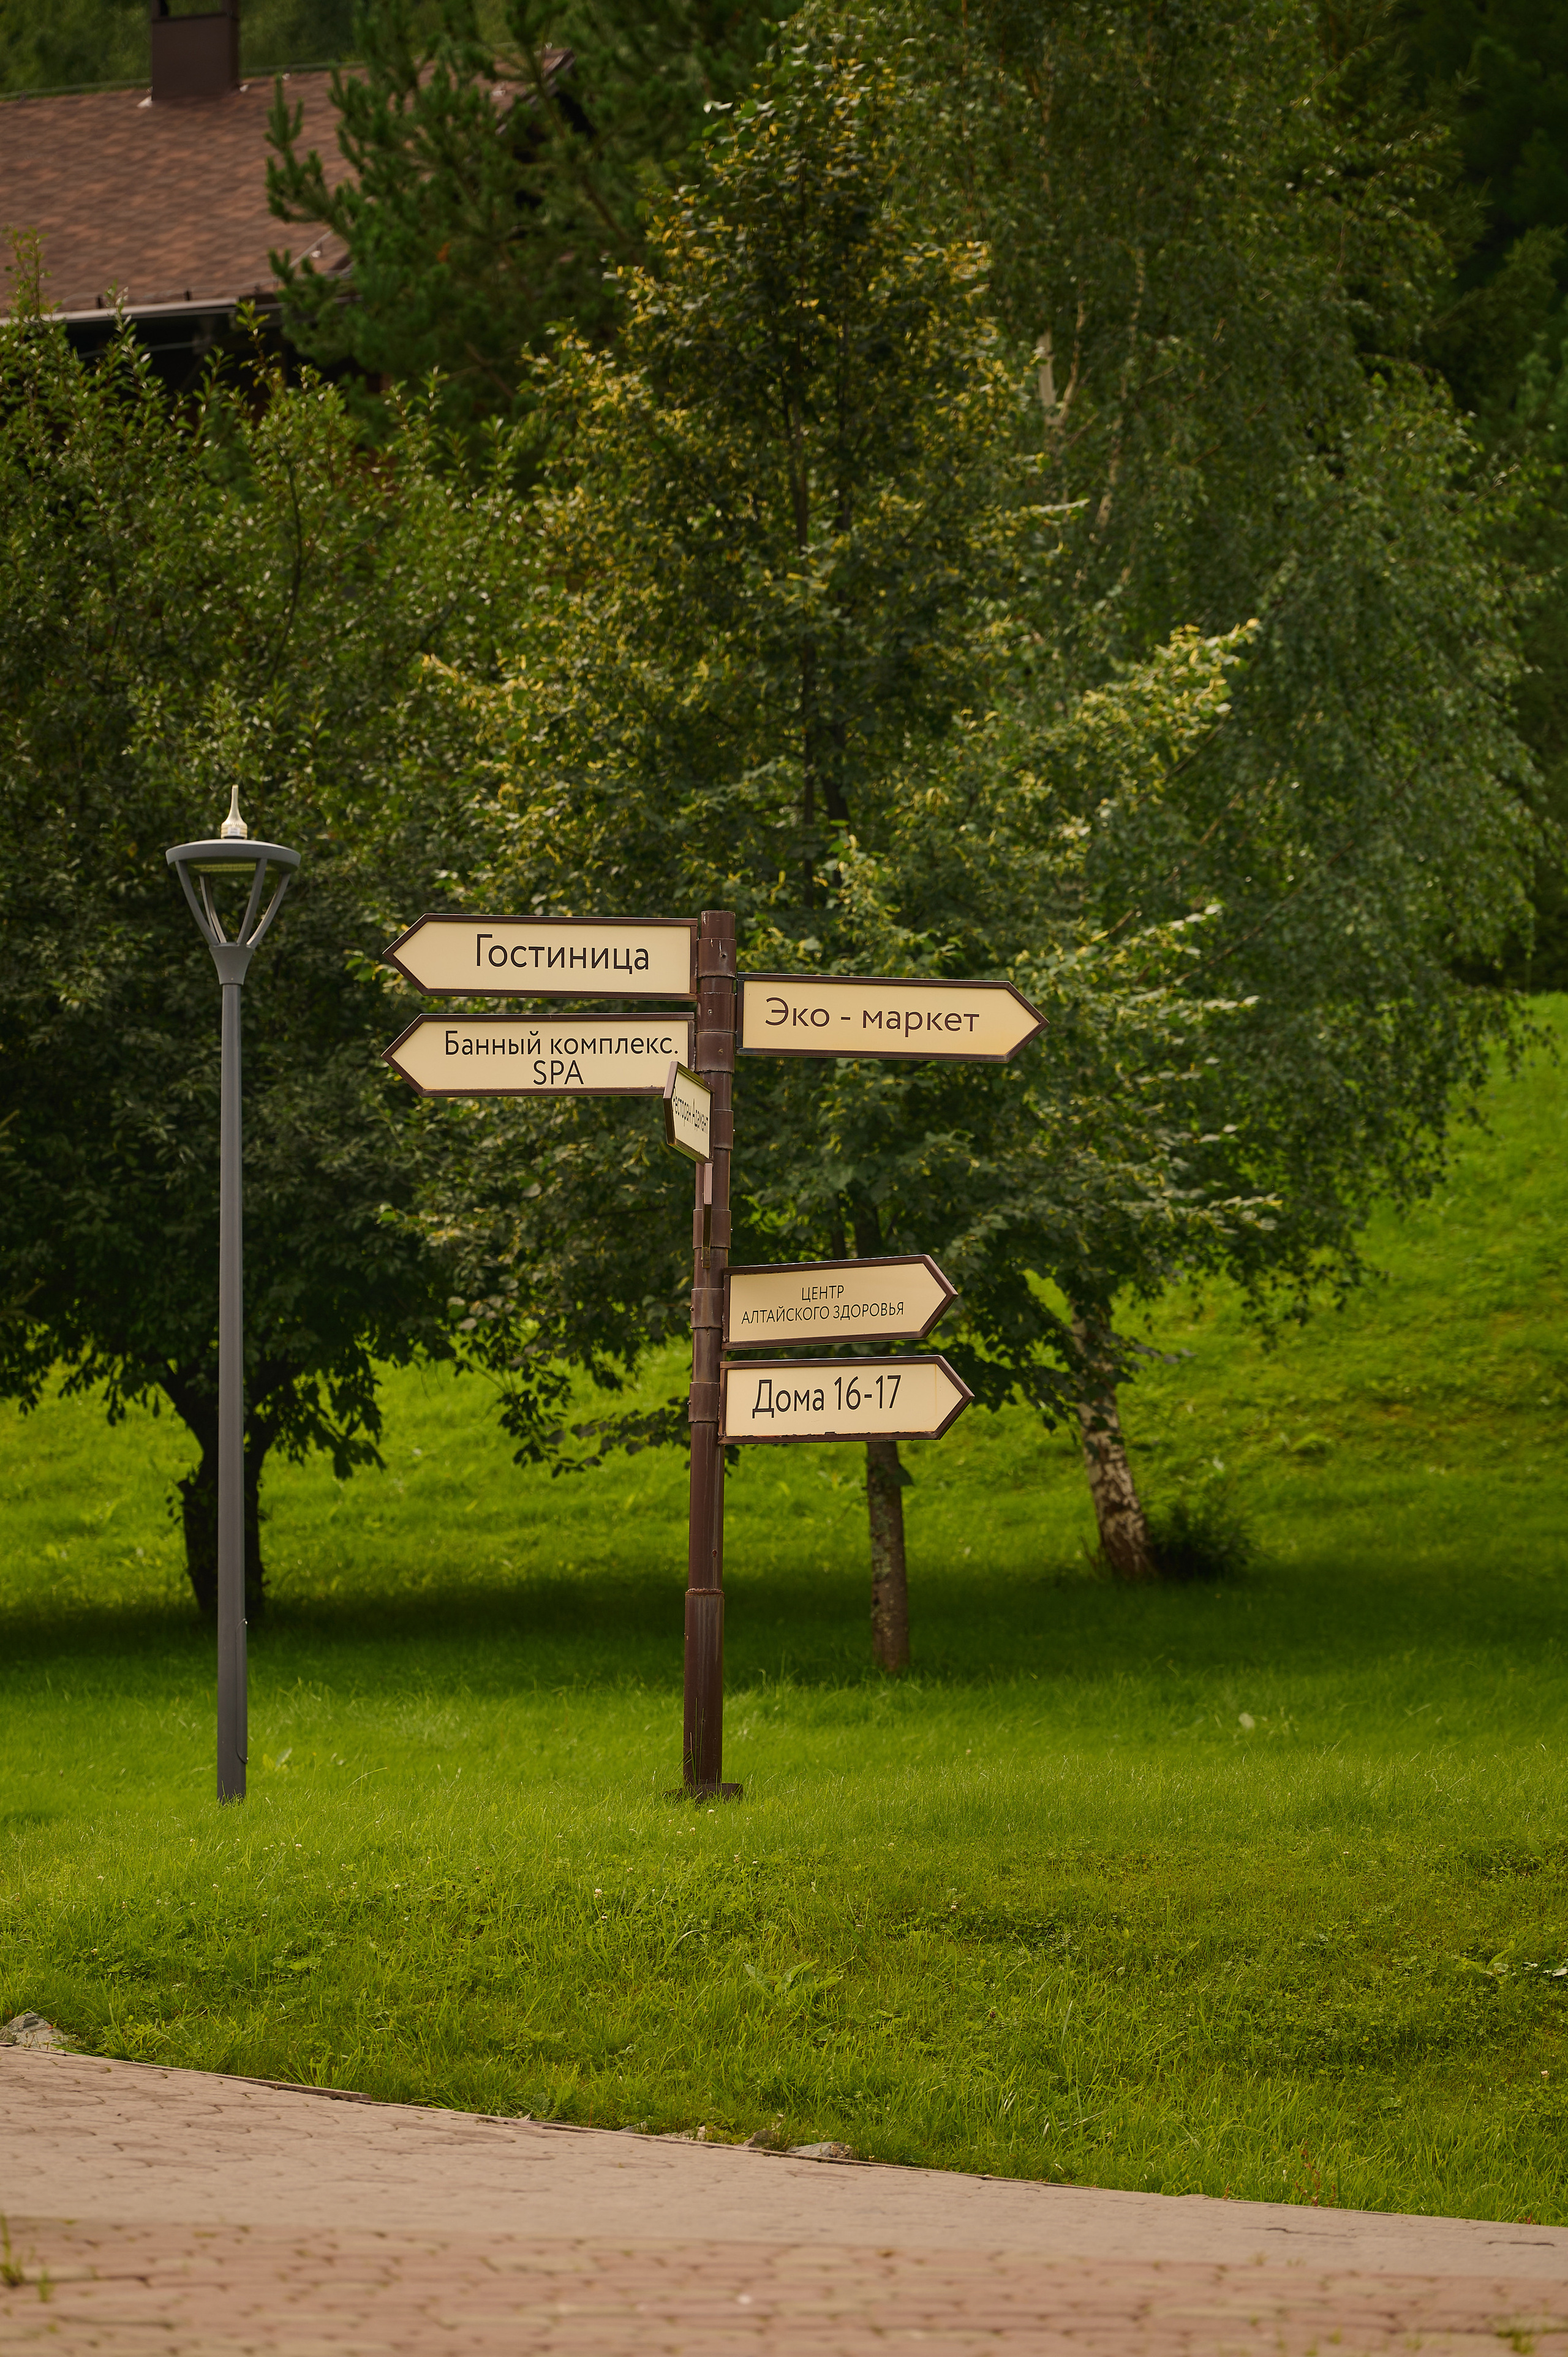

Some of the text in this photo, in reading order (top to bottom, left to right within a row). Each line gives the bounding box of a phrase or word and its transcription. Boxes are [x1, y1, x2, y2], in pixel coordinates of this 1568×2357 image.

[475, 933, 649, 975] Гостиница
[764, 997, 831, 1028] Эко
[862, 1009, 981, 1036] маркет
[445, 1030, 679, 1056] Банный комплекс.
[532, 1059, 585, 1086] SPA
[801, 1284, 845, 1303] ЦЕНТР
[741, 1301, 905, 1325] АЛТАЙСКОГО ЗДОРОВЬЯ
[751, 1374, 902, 1420] Дома 16-17
